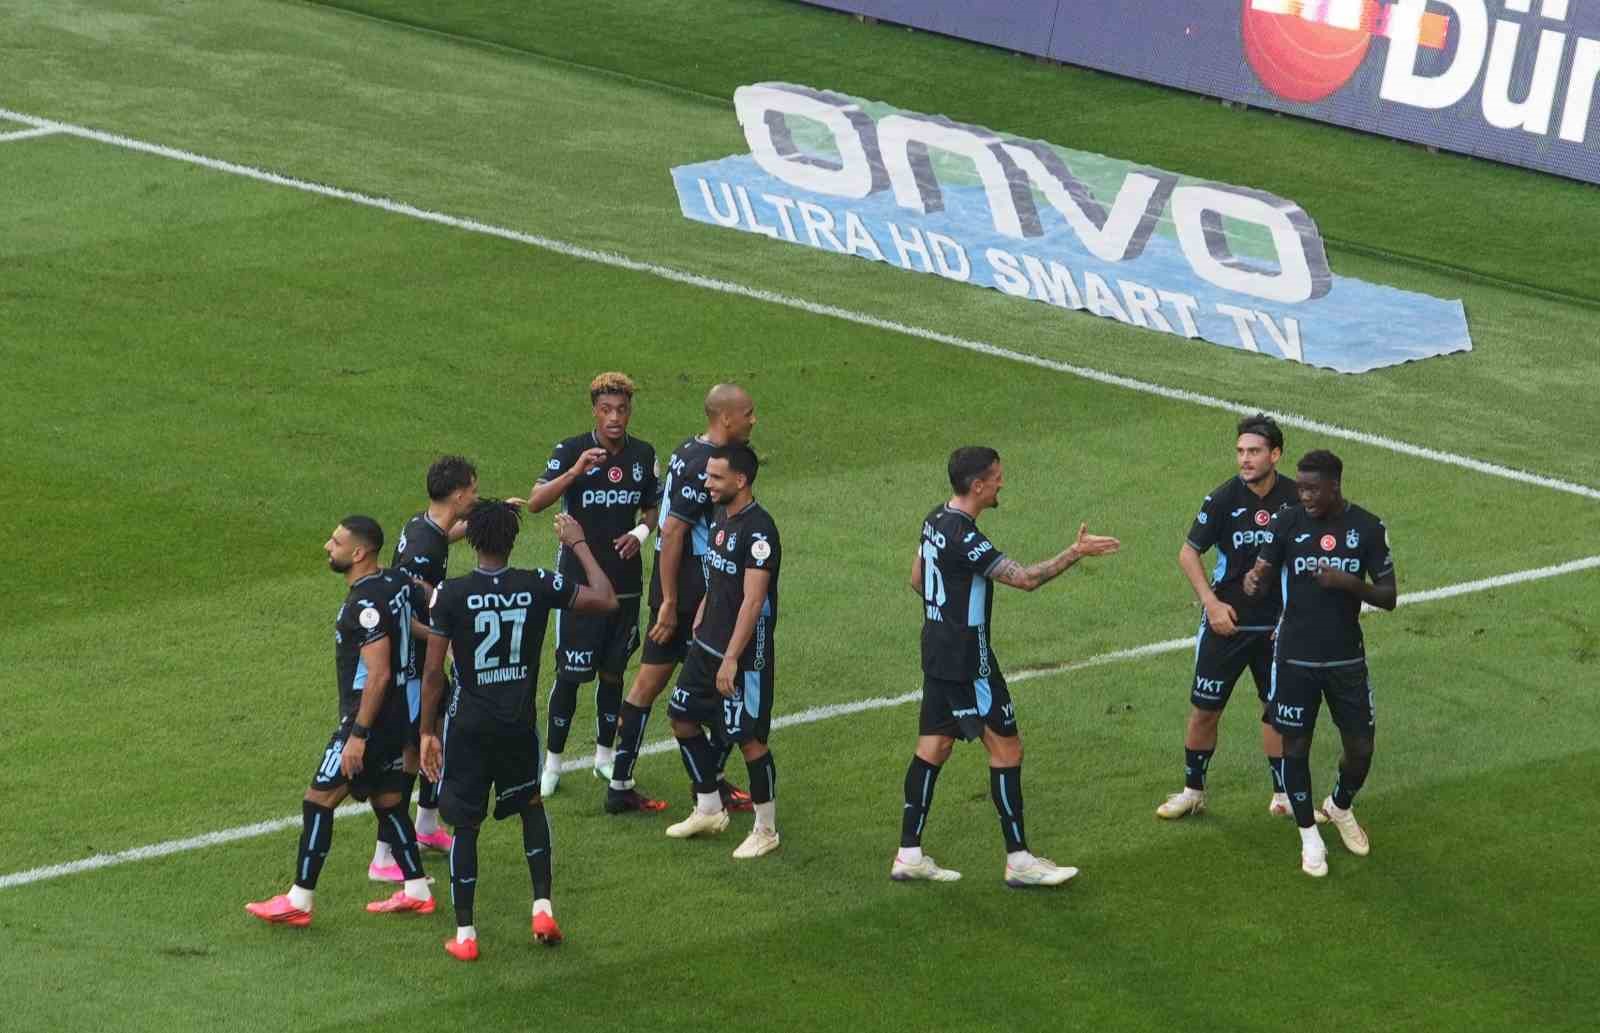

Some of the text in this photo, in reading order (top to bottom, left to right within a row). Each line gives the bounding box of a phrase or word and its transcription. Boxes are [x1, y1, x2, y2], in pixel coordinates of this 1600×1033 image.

[698, 178, 1304, 362] ULTRA HD SMART TV
[582, 489, 642, 508] papara
[967, 540, 993, 562] QNB
[1294, 556, 1361, 575] papara
[474, 607, 528, 670] 27
[565, 650, 594, 665] YKT
[1196, 676, 1225, 693] YKT
[723, 699, 744, 728] 57
[1277, 702, 1304, 720] YKT
